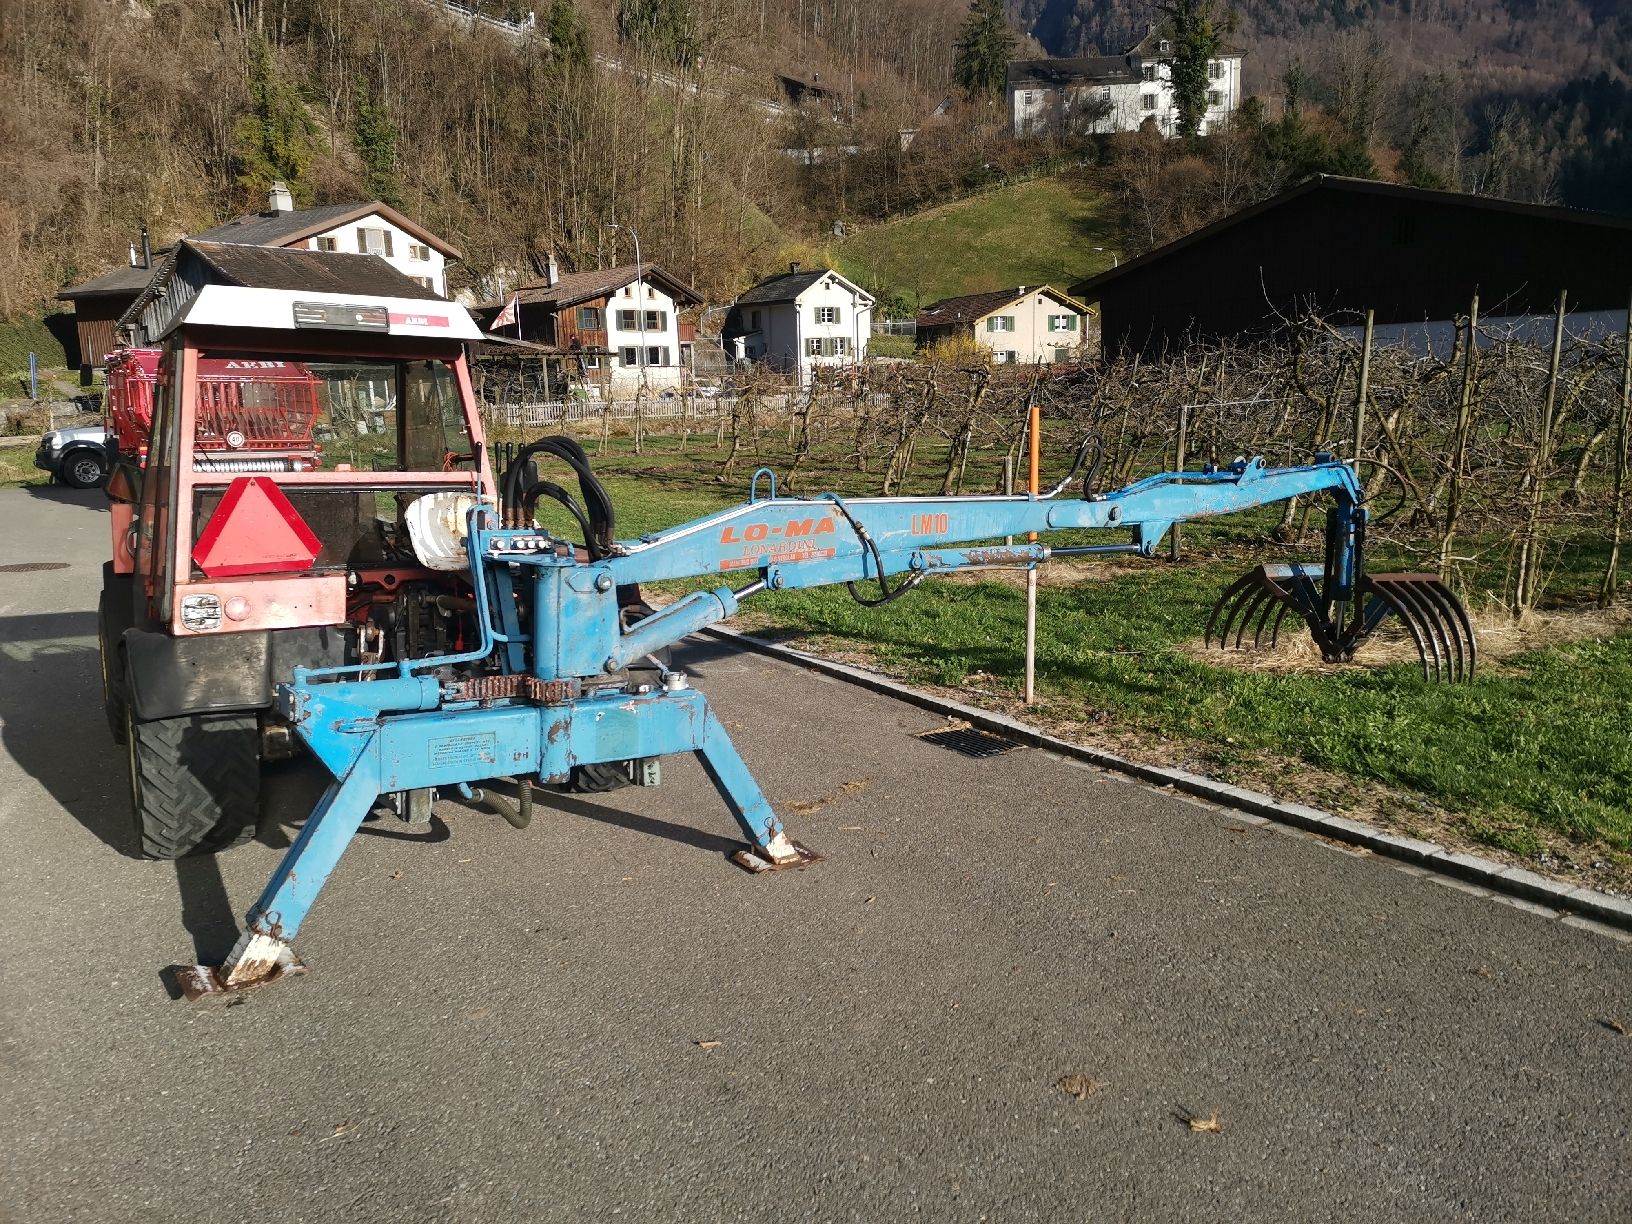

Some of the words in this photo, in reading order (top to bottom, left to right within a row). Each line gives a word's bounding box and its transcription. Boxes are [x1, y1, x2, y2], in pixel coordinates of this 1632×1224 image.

[225, 361, 286, 369] AEBI
[720, 517, 836, 544] LO-MA
[742, 538, 817, 556] LONARDINI
